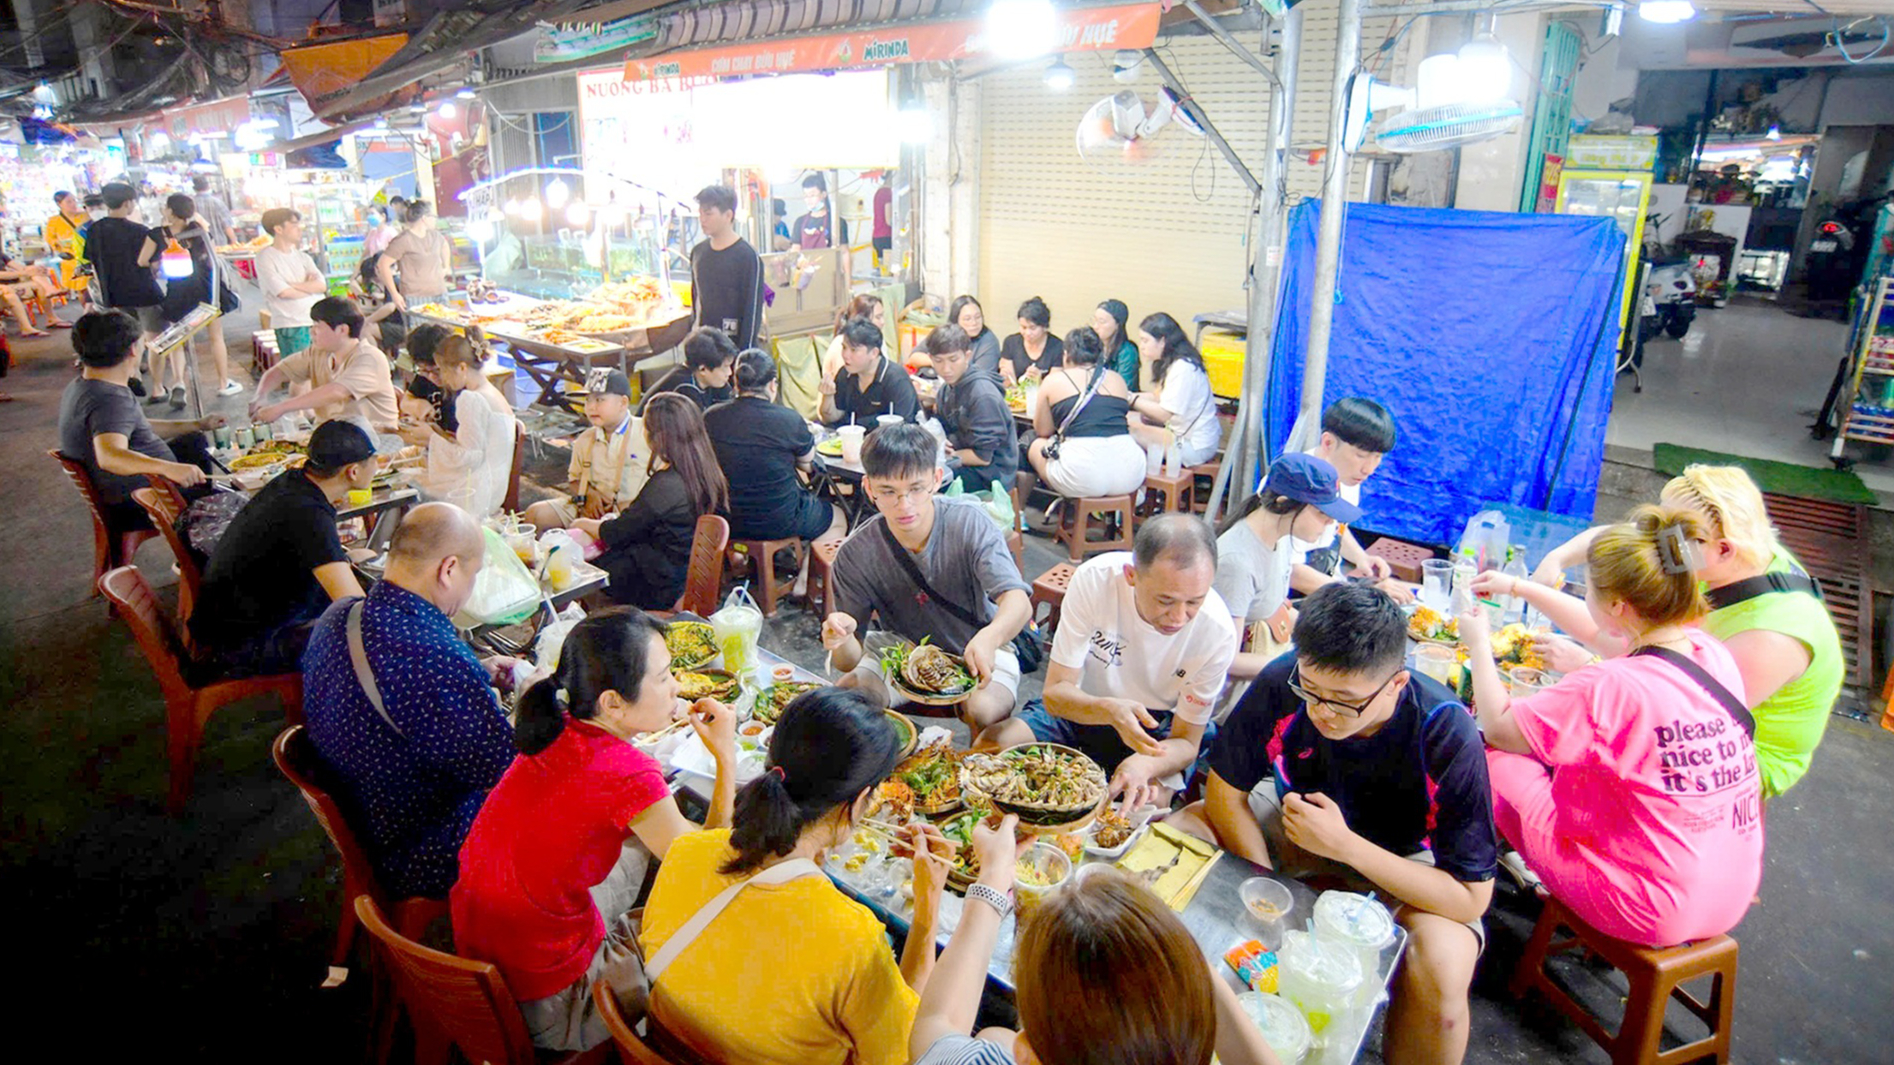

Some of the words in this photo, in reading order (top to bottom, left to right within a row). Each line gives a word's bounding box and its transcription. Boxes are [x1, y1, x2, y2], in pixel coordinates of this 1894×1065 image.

[1654, 718, 1726, 748] please
[1660, 744, 1714, 768] nice
[1716, 740, 1737, 761] to
[1660, 768, 1708, 793] it's
[1711, 764, 1741, 789] the
